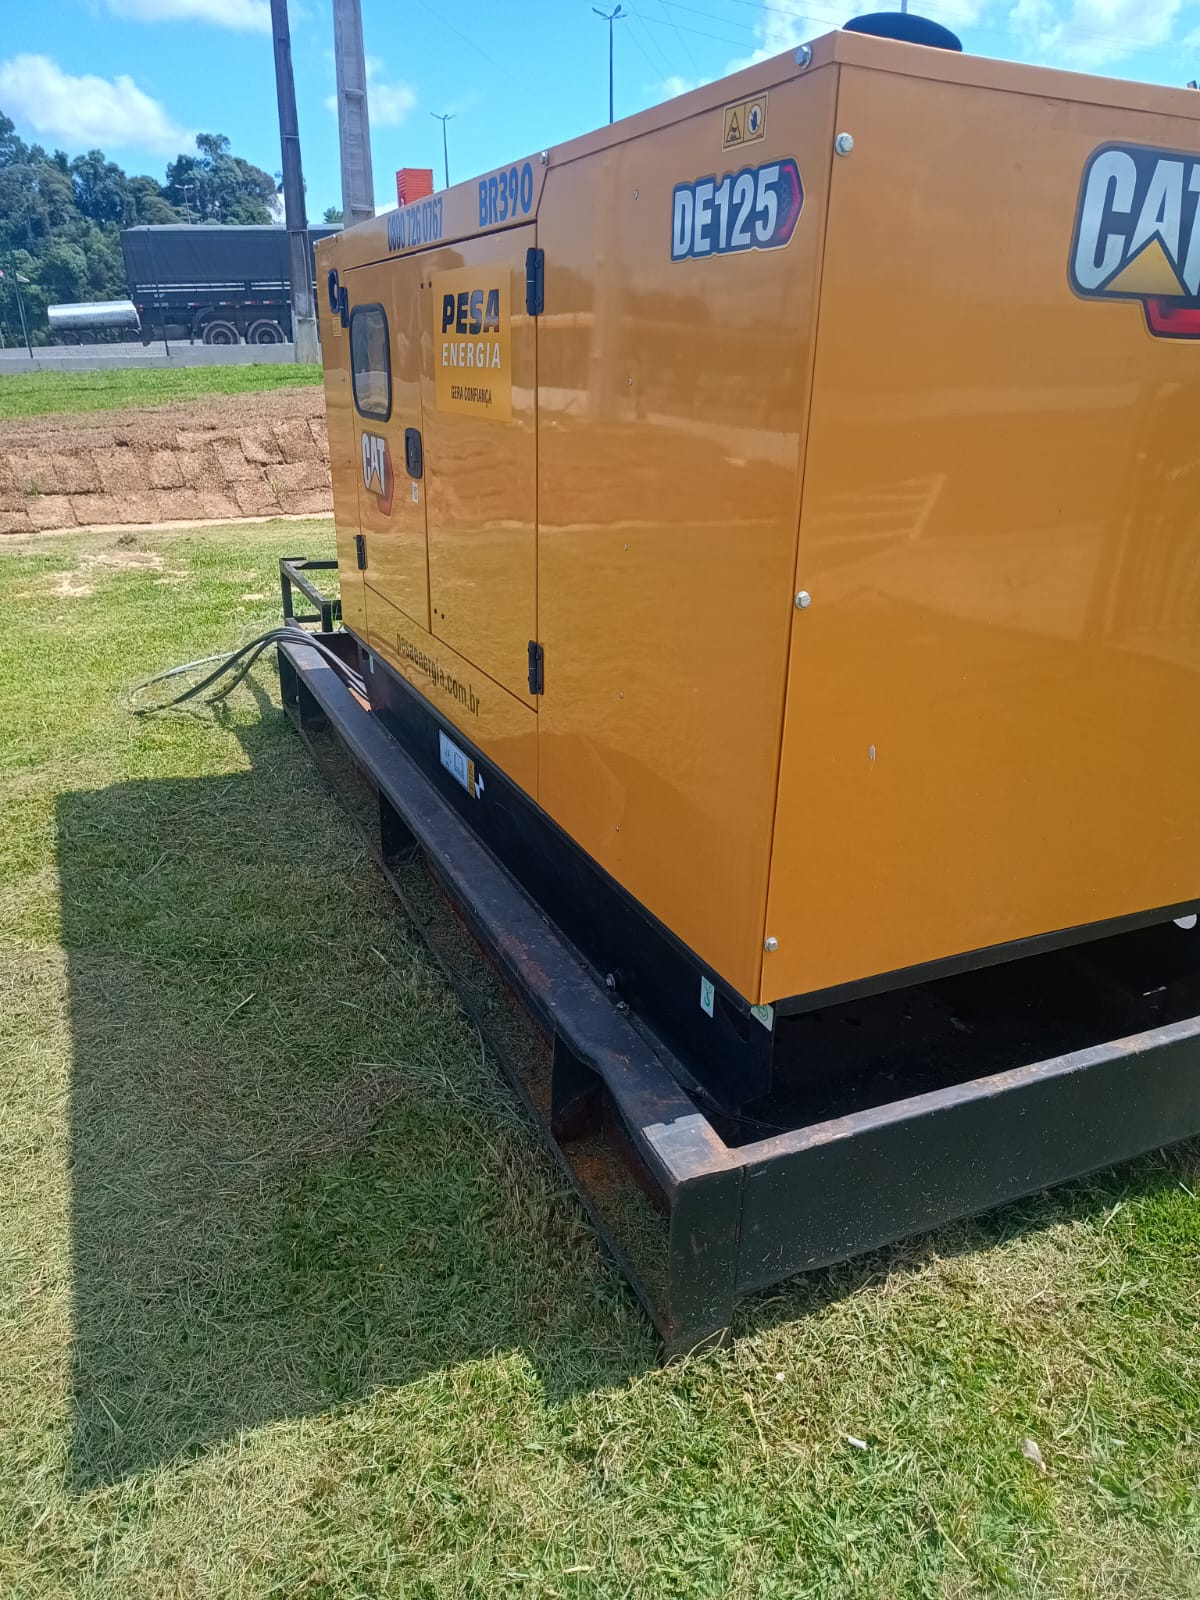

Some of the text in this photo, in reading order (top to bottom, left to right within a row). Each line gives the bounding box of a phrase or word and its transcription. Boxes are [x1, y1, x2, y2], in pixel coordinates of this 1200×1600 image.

[387, 197, 443, 252] 0800 726 0767
[479, 161, 533, 227] BR390
[673, 165, 780, 256] DE125
[442, 289, 500, 335] PESA
[442, 342, 501, 369] ENERGIA
[361, 432, 386, 497] CAT
[396, 633, 480, 717] pesaenergia.com.br
